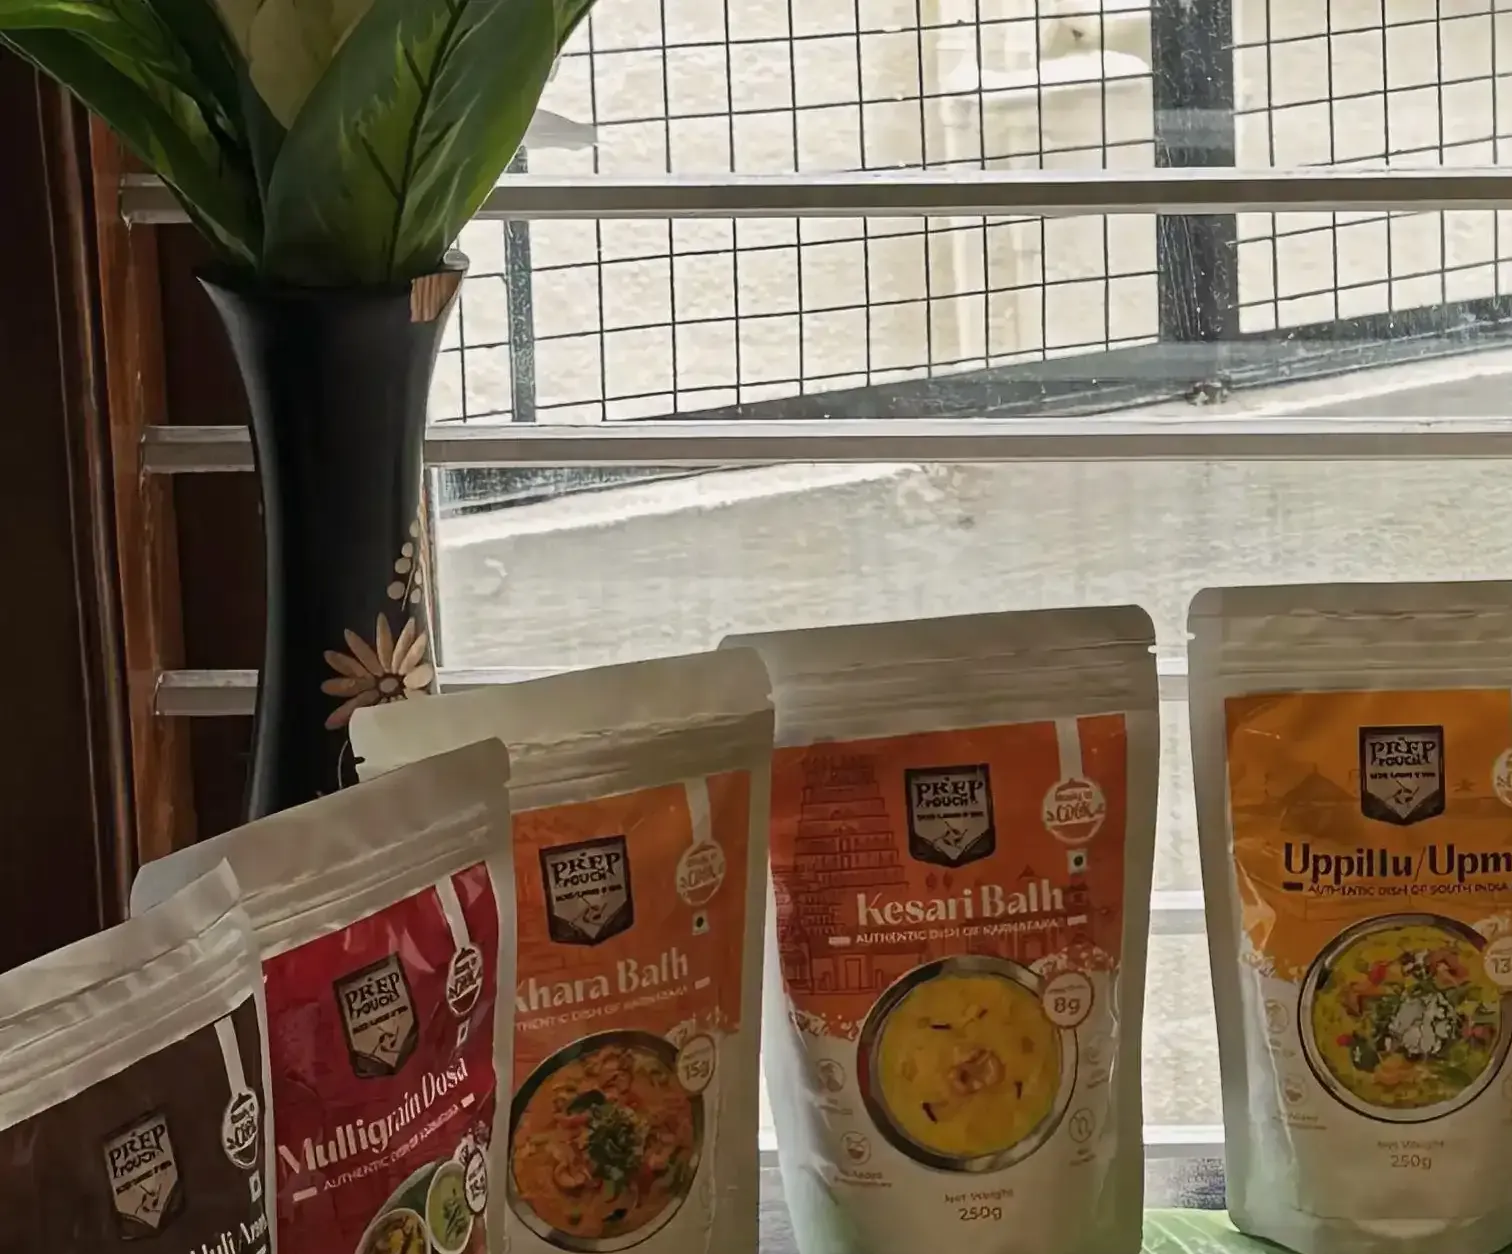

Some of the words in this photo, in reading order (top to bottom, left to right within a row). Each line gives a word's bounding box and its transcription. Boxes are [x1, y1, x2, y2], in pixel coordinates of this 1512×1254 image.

[1369, 739, 1436, 765] PREP
[915, 778, 984, 807] PREP
[924, 795, 970, 808] POUCH
[550, 851, 621, 885] PREP
[562, 872, 607, 888] POUCH
[1308, 883, 1375, 896] AUTHENTIC
[856, 890, 973, 928] Kesari
[344, 972, 400, 1018] PREP
[1054, 996, 1080, 1016] 8g
[422, 1057, 469, 1109] Dosa
[109, 1123, 167, 1167] PREP
[323, 1157, 390, 1191] AUTHENTIC
[1390, 1154, 1432, 1170] 250g
[958, 1206, 1003, 1222] 250g
